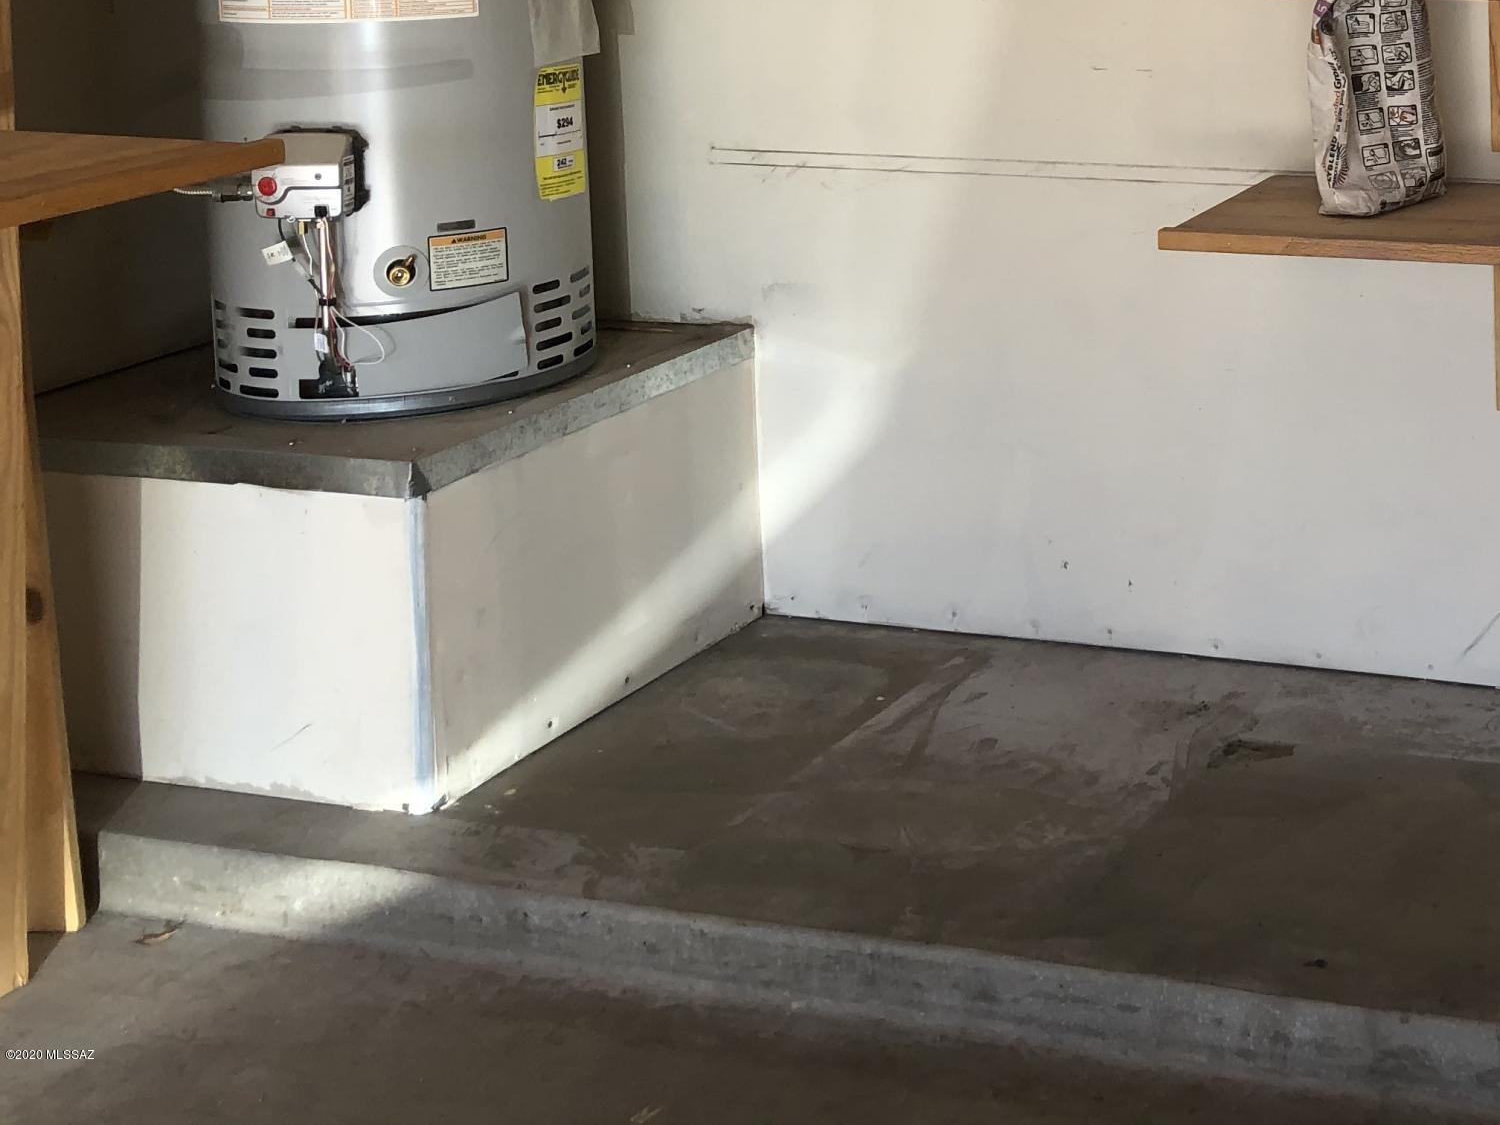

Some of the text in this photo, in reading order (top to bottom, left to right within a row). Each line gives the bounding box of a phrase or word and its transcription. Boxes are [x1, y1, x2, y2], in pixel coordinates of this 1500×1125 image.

[1317, 3, 1328, 14] 5
[557, 117, 573, 129] $294
[457, 234, 487, 243] WARNING
